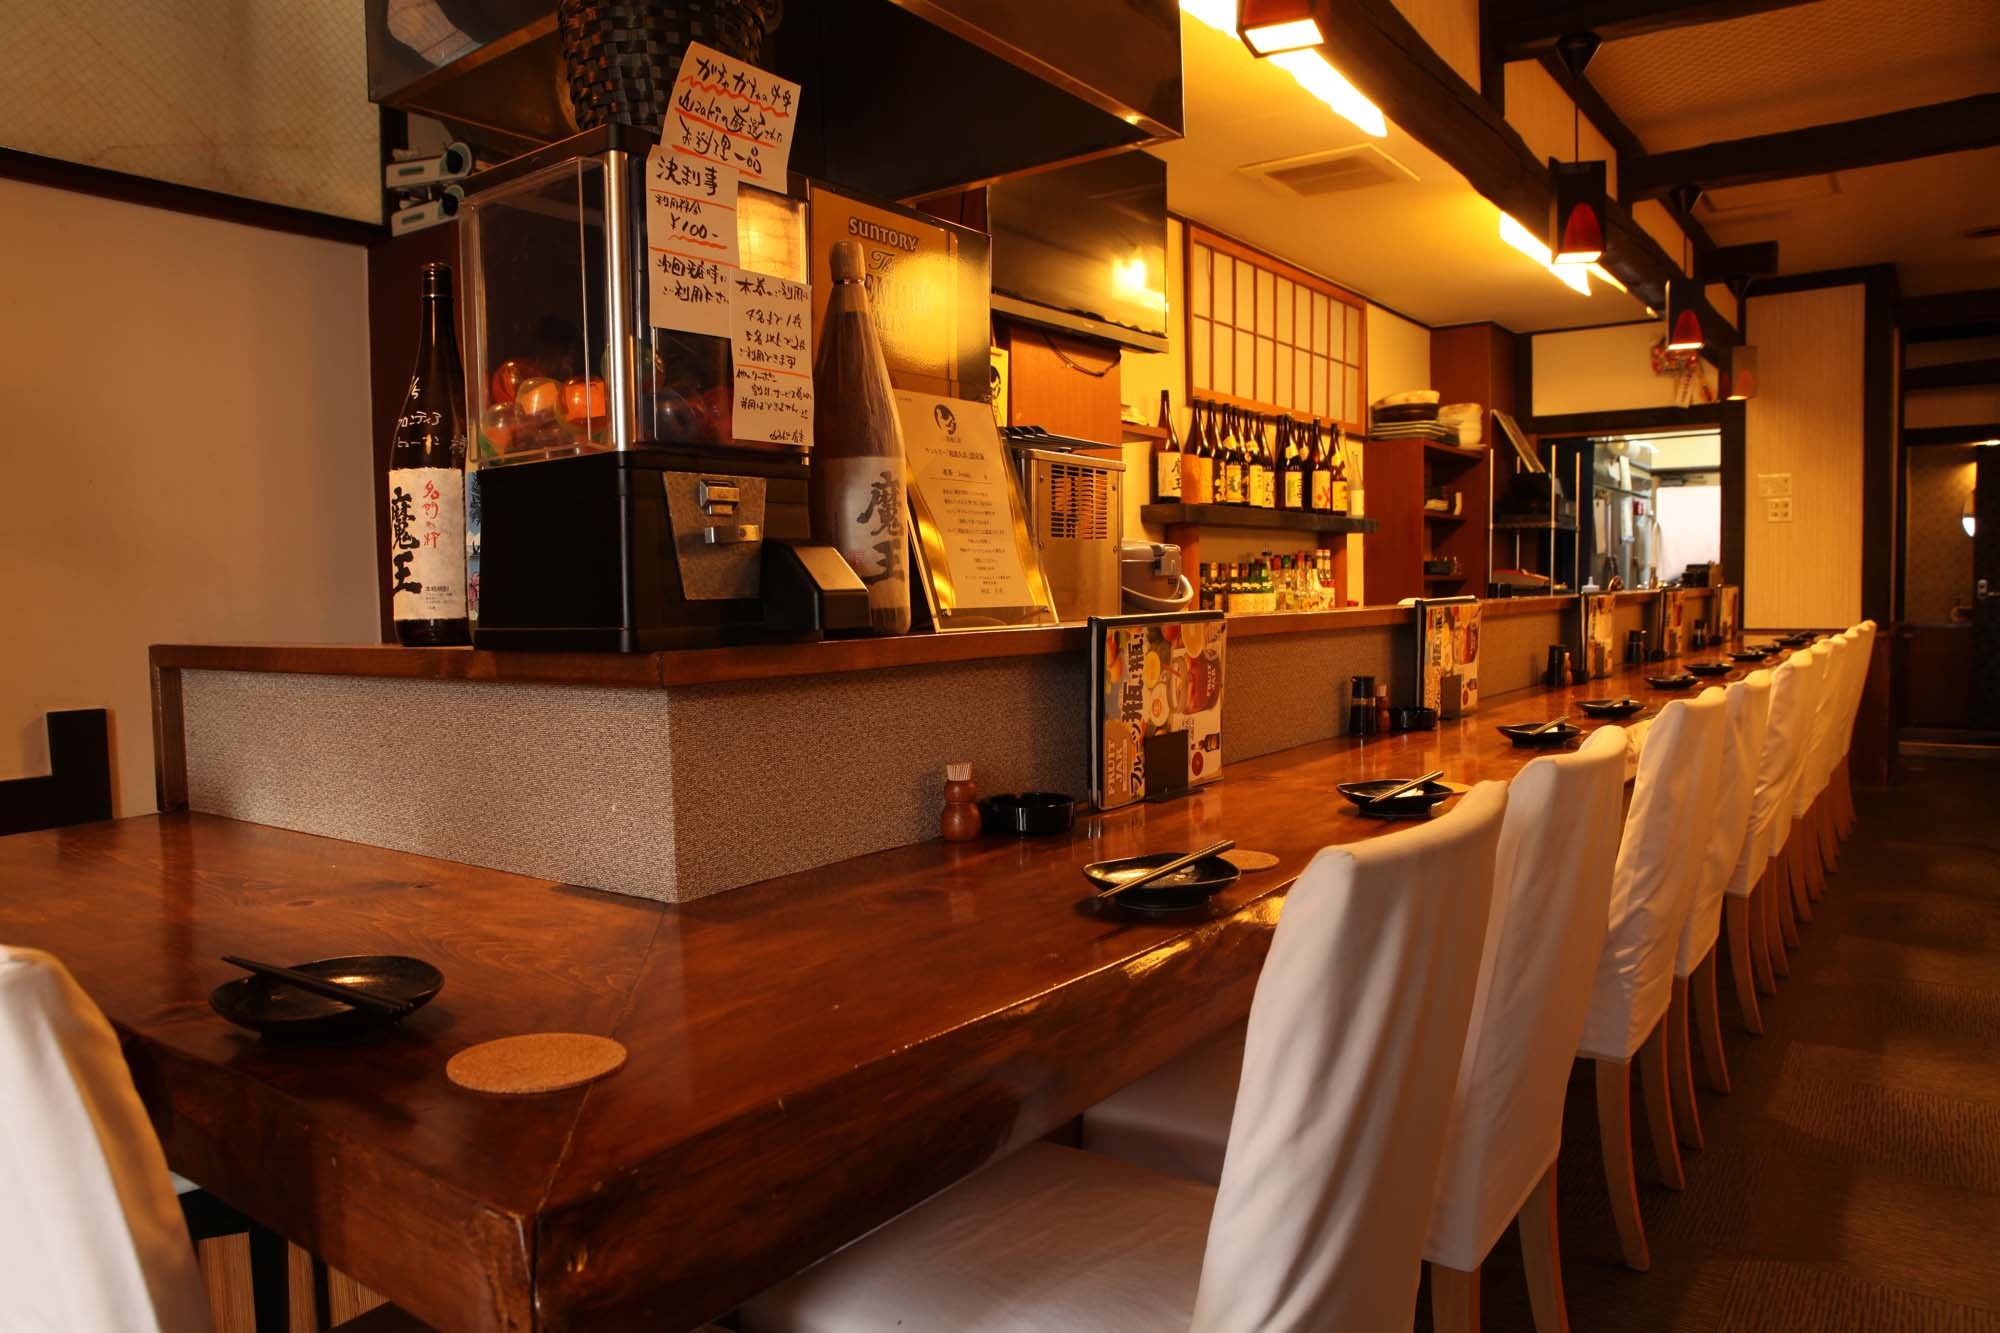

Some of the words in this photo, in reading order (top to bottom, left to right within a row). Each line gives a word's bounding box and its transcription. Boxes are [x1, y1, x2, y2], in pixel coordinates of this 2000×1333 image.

[849, 217, 919, 252] SUNTORY
[391, 486, 422, 597] 魔王
[1107, 739, 1117, 795] FRUIT
